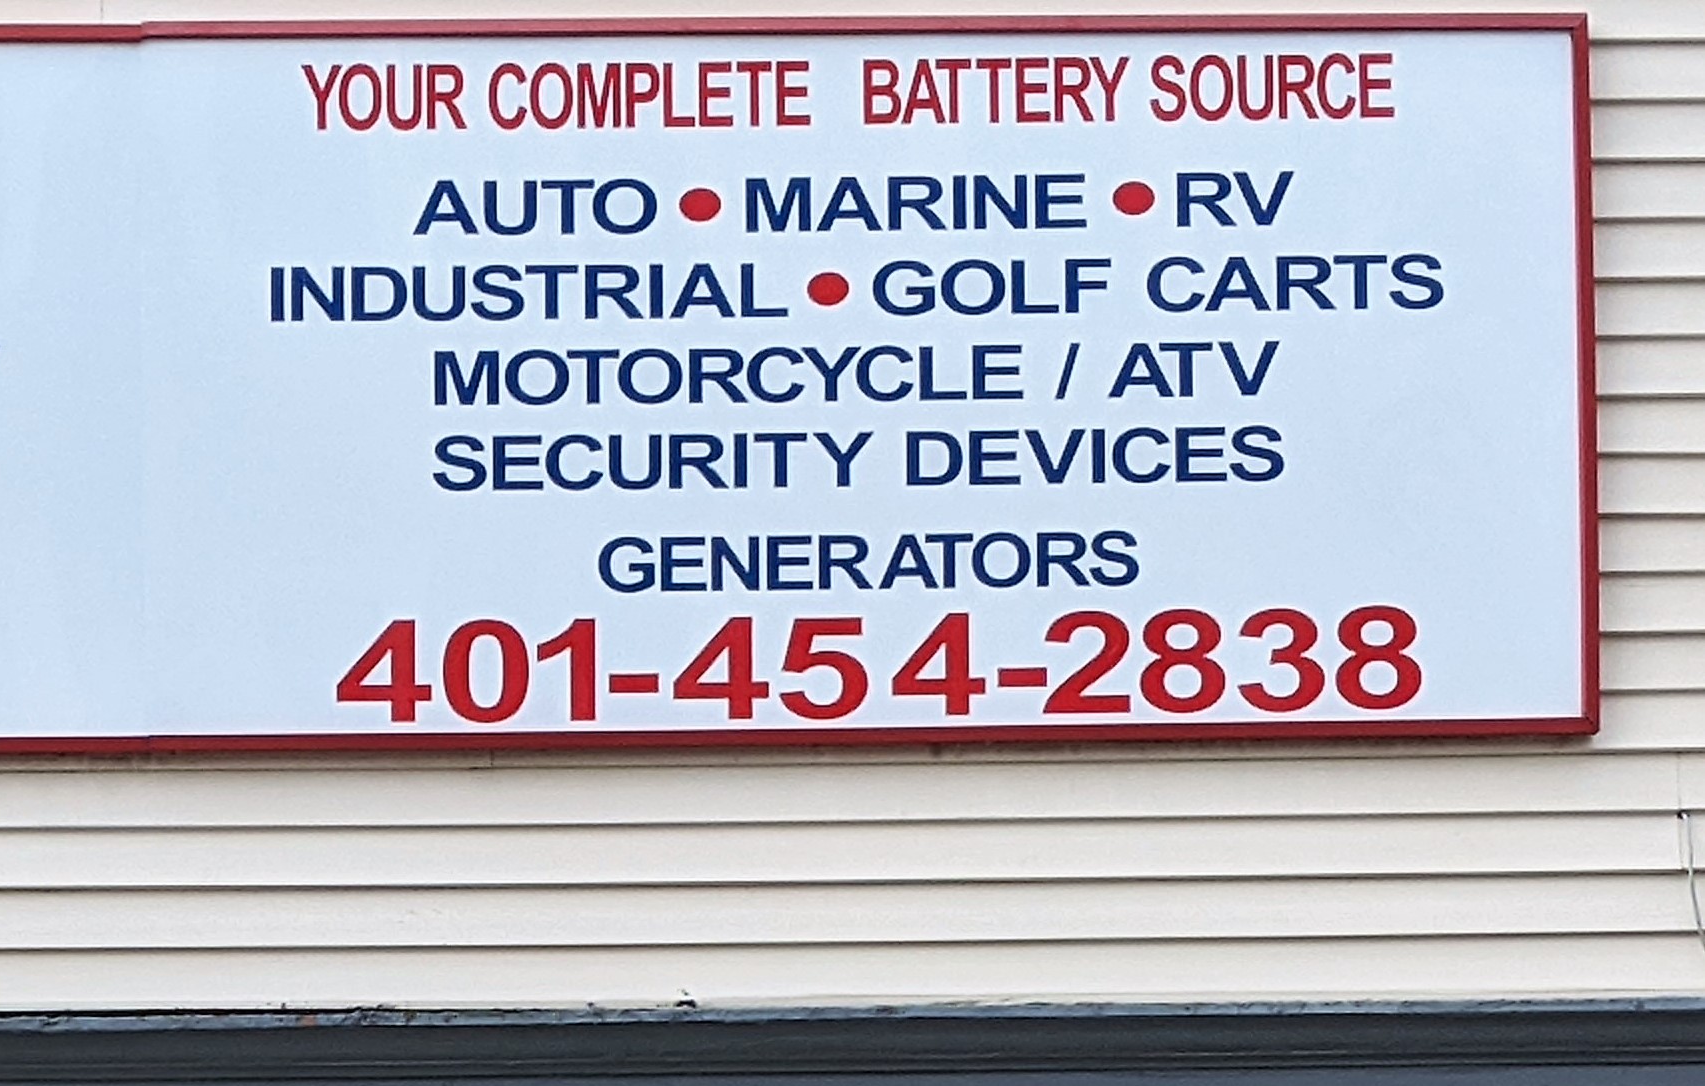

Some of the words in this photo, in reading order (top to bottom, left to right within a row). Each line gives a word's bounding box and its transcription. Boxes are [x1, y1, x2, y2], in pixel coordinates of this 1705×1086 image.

[300, 63, 468, 131] YOUR
[488, 60, 811, 130] COMPLETE
[863, 56, 1130, 125] BATTERY
[1150, 52, 1395, 122] SOURCE
[412, 178, 658, 236] AUTO
[745, 173, 1088, 233] MARINE
[1176, 170, 1295, 228] RV
[270, 262, 789, 322] INDUSTRIAL
[872, 258, 1112, 317] GOLF
[1146, 253, 1445, 313] CARTS
[434, 344, 1024, 406] MOTORCYCLE
[1055, 342, 1081, 400] /
[1108, 340, 1280, 398] ATV
[432, 431, 874, 492] SECURITY
[906, 425, 1285, 487] DEVICES
[598, 530, 1140, 594] GENERATORS
[336, 604, 1424, 726] 401-454-2838
